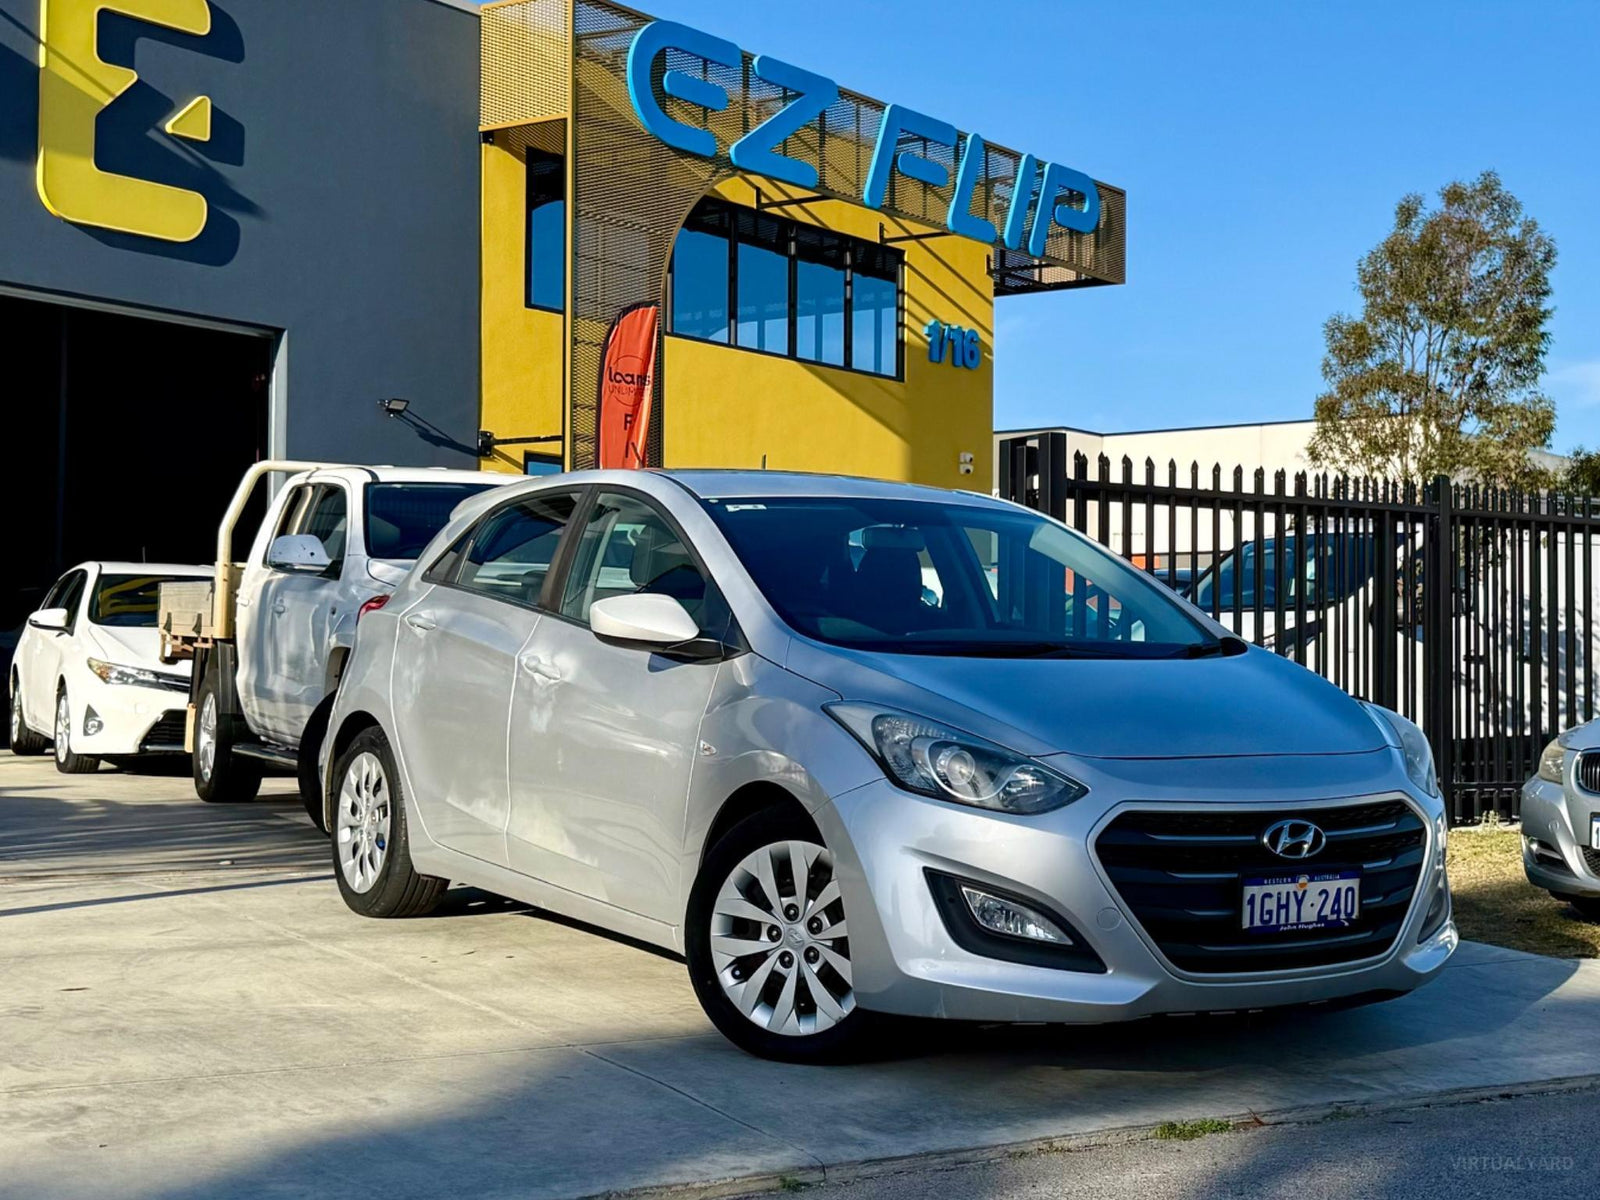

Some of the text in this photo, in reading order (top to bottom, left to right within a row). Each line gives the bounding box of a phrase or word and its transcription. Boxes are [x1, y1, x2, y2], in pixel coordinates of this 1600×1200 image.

[627, 20, 1100, 258] EZ FLIP
[924, 319, 981, 371] 1/16
[609, 366, 651, 387] loans
